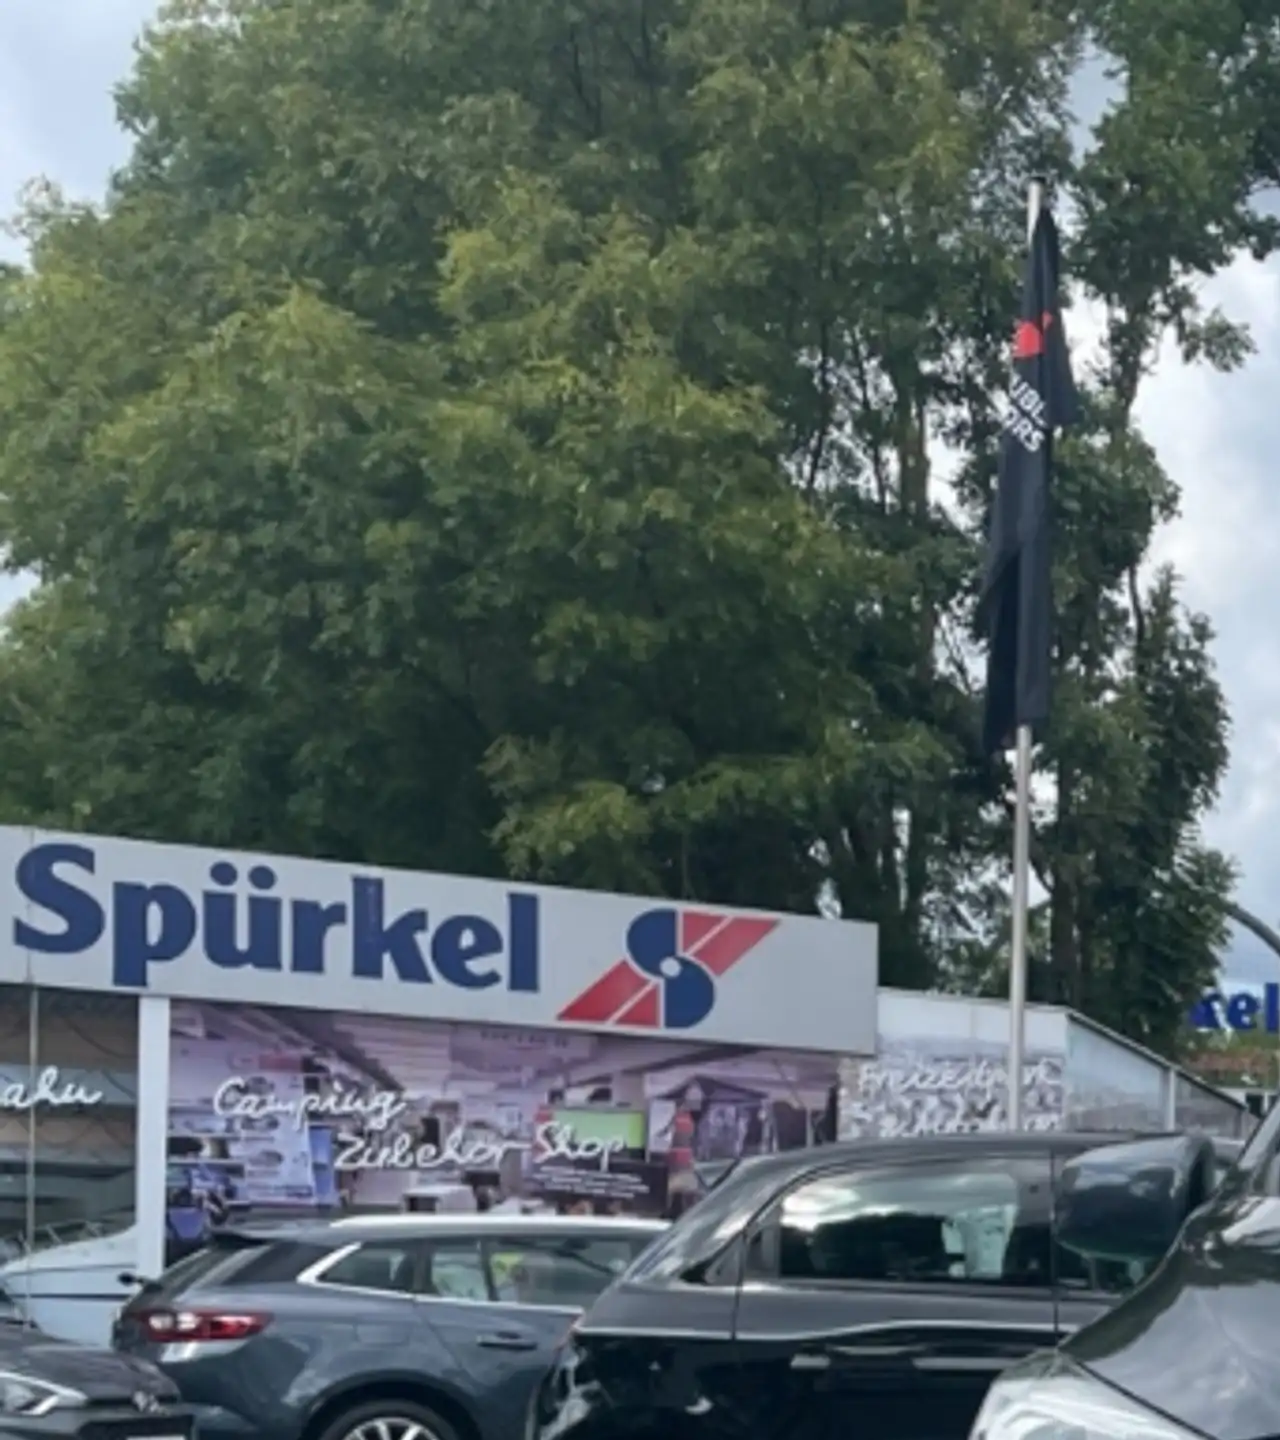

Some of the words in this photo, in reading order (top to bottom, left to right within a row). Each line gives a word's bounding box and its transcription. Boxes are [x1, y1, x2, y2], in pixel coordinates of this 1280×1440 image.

[14, 843, 540, 992] Spürkel
[213, 1075, 407, 1131] Camping
[534, 1120, 624, 1172] Shop
